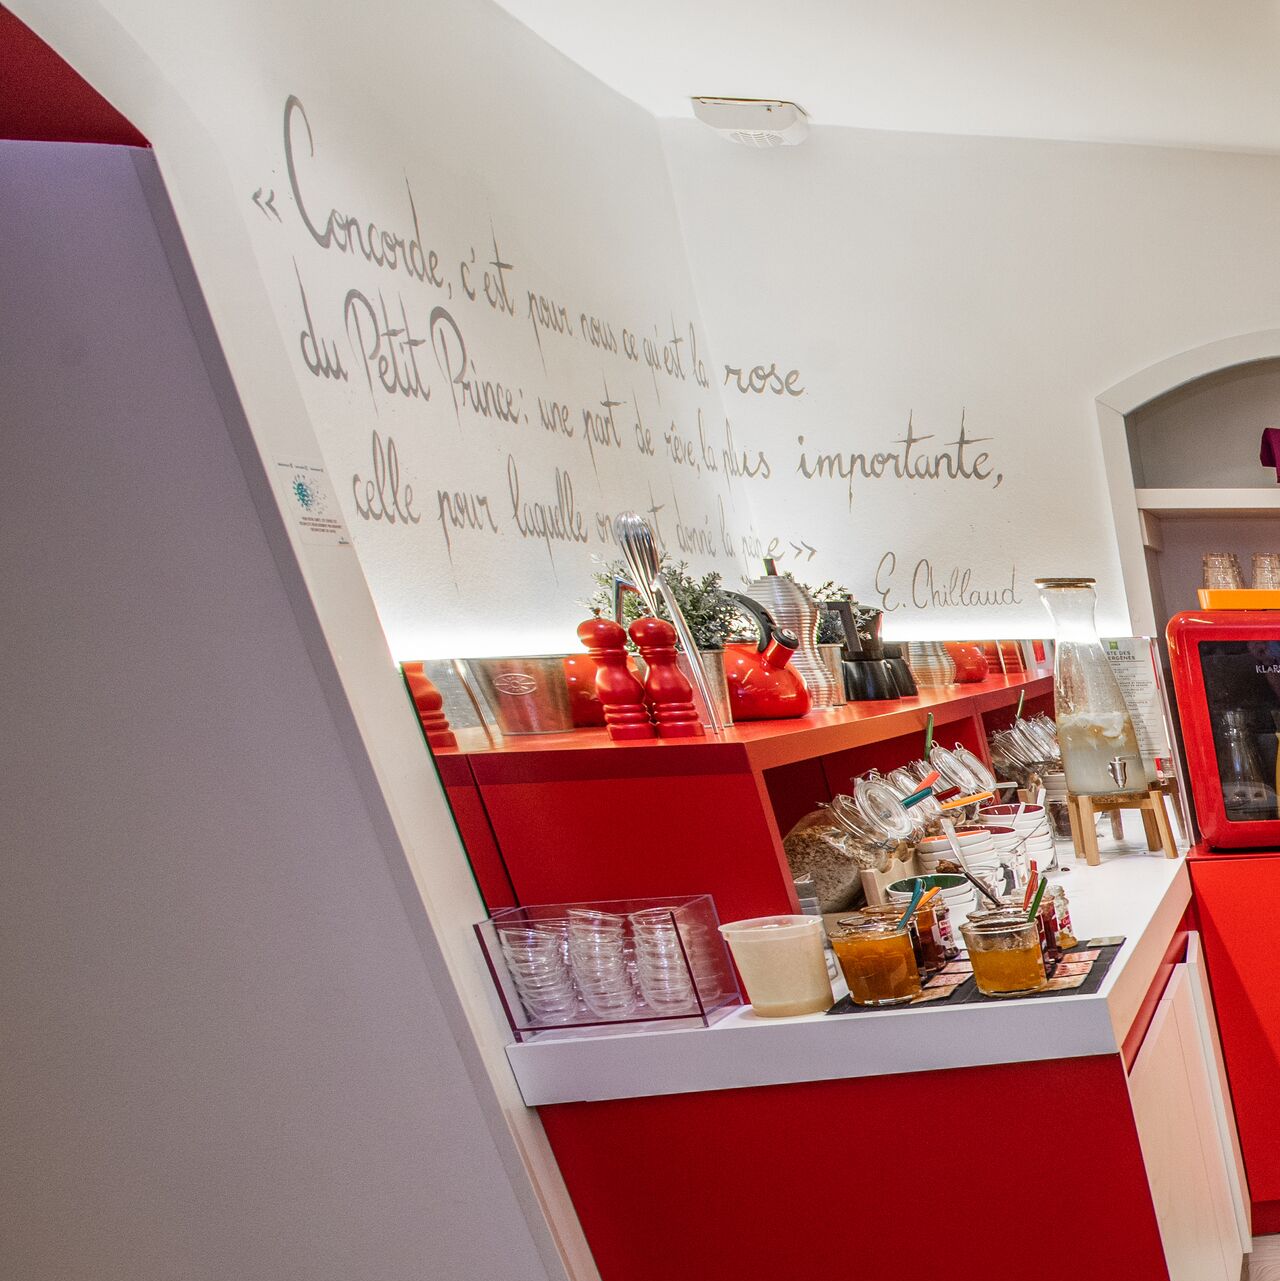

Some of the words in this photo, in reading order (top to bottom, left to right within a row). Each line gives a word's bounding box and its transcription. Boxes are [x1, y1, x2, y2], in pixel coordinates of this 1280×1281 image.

[284, 94, 453, 300] Concorde,
[528, 290, 573, 378] pour
[581, 313, 617, 354] nous
[623, 328, 639, 362] ce
[690, 320, 710, 388] la
[724, 362, 806, 397] rose
[292, 255, 349, 382] du
[344, 287, 430, 420] Petit
[537, 396, 574, 438] une
[583, 368, 627, 489] part
[632, 387, 655, 457] de
[697, 408, 718, 472] la
[723, 417, 771, 512] plus
[797, 406, 1003, 513] importante,
[352, 429, 421, 524] celle
[437, 488, 499, 570] pour
[507, 453, 589, 586] laquelle
[912, 558, 1022, 608] Chillaud
